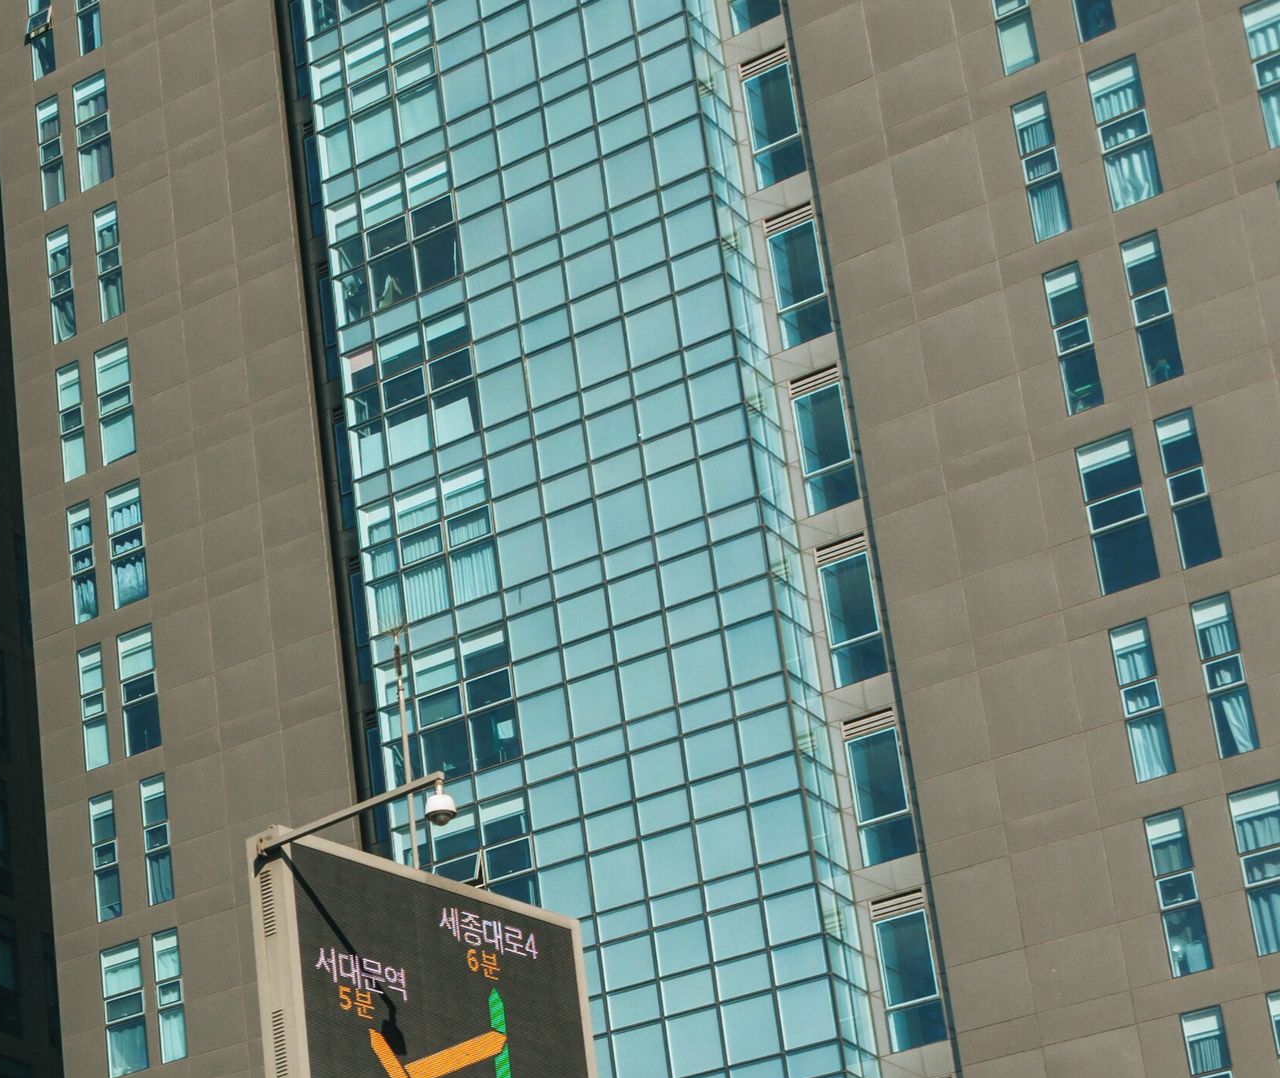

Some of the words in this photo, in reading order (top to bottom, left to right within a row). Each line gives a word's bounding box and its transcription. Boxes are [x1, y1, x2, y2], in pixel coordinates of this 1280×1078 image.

[439, 907, 538, 960] 세종대로4
[315, 946, 408, 1003] 서대문역
[466, 948, 500, 981] 6분
[338, 985, 375, 1020] 5분
